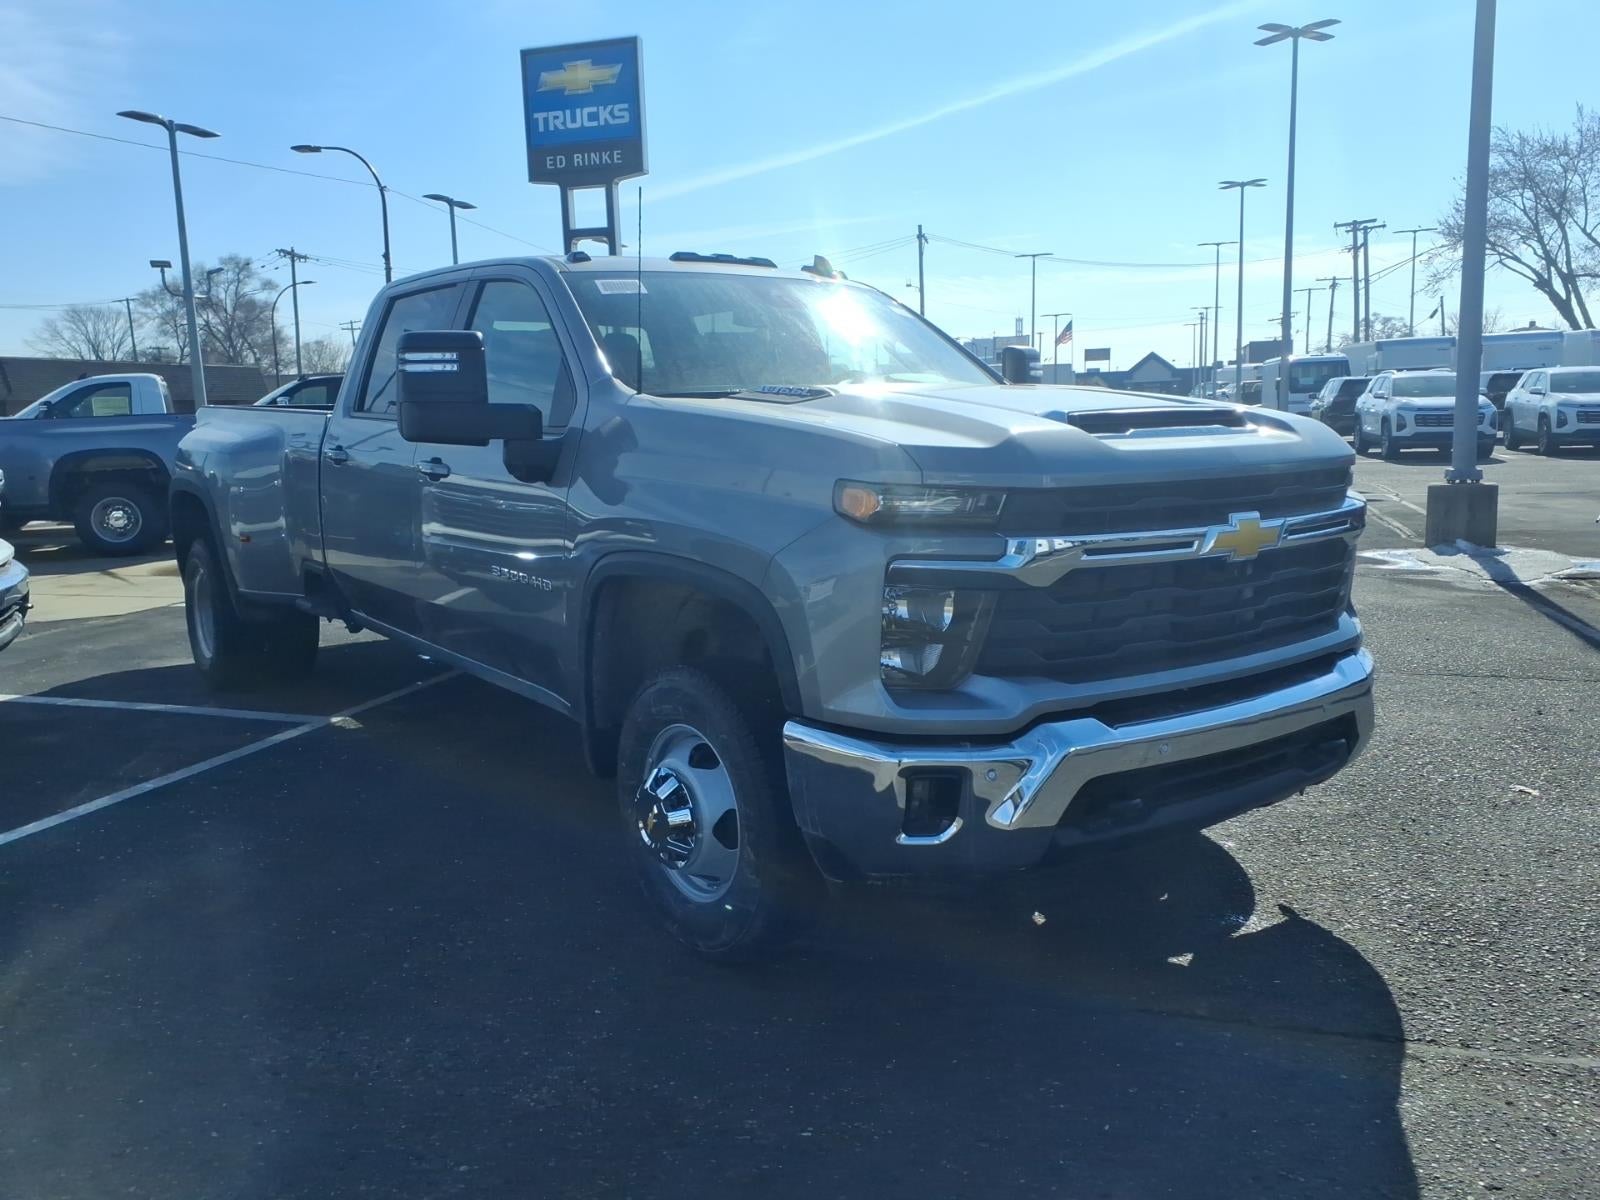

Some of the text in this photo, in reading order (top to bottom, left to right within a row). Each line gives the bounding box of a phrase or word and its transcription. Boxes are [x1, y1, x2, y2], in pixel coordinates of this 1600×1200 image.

[533, 103, 630, 132] TRUCKS
[546, 150, 623, 169] ED RINKE
